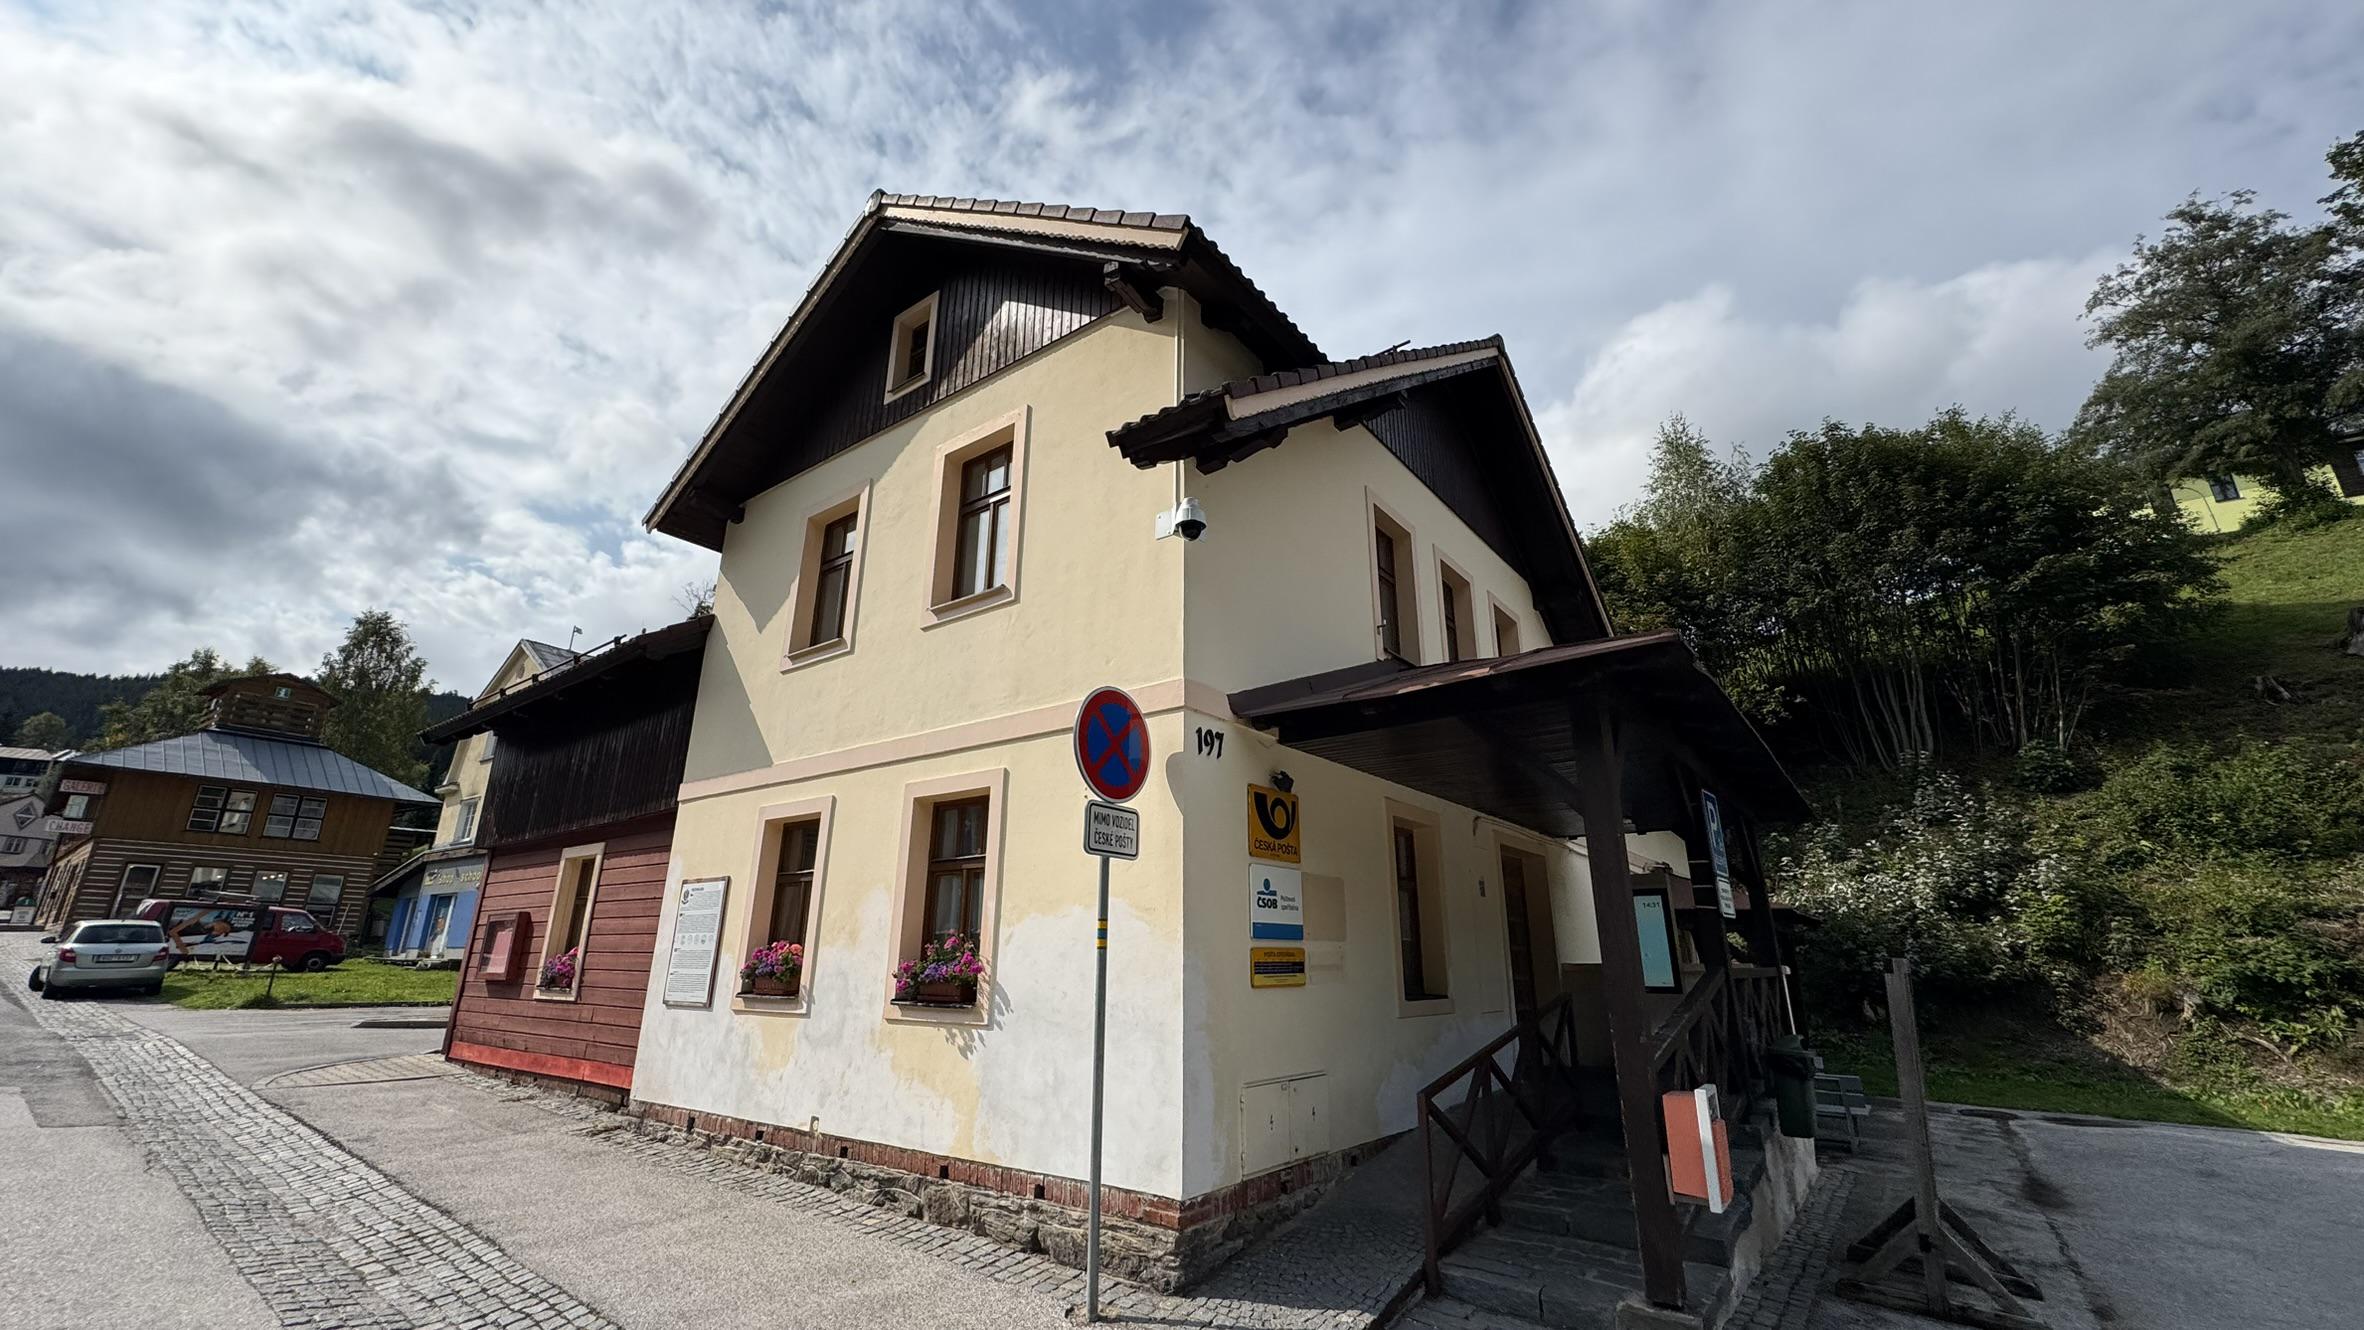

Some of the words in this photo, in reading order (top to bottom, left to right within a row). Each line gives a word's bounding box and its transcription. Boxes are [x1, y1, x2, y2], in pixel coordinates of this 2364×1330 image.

[1195, 726, 1225, 760] 197
[49, 820, 91, 833] CHANGE
[1093, 811, 1110, 827] MIMO
[1111, 814, 1135, 831] VOZIDEL
[1094, 828, 1113, 847] ČESKÉ
[1114, 833, 1134, 849] POŠTY
[1254, 837, 1276, 852] ČESKÁ
[1276, 842, 1298, 856] POŠTA
[1256, 896, 1278, 910] ČSOB
